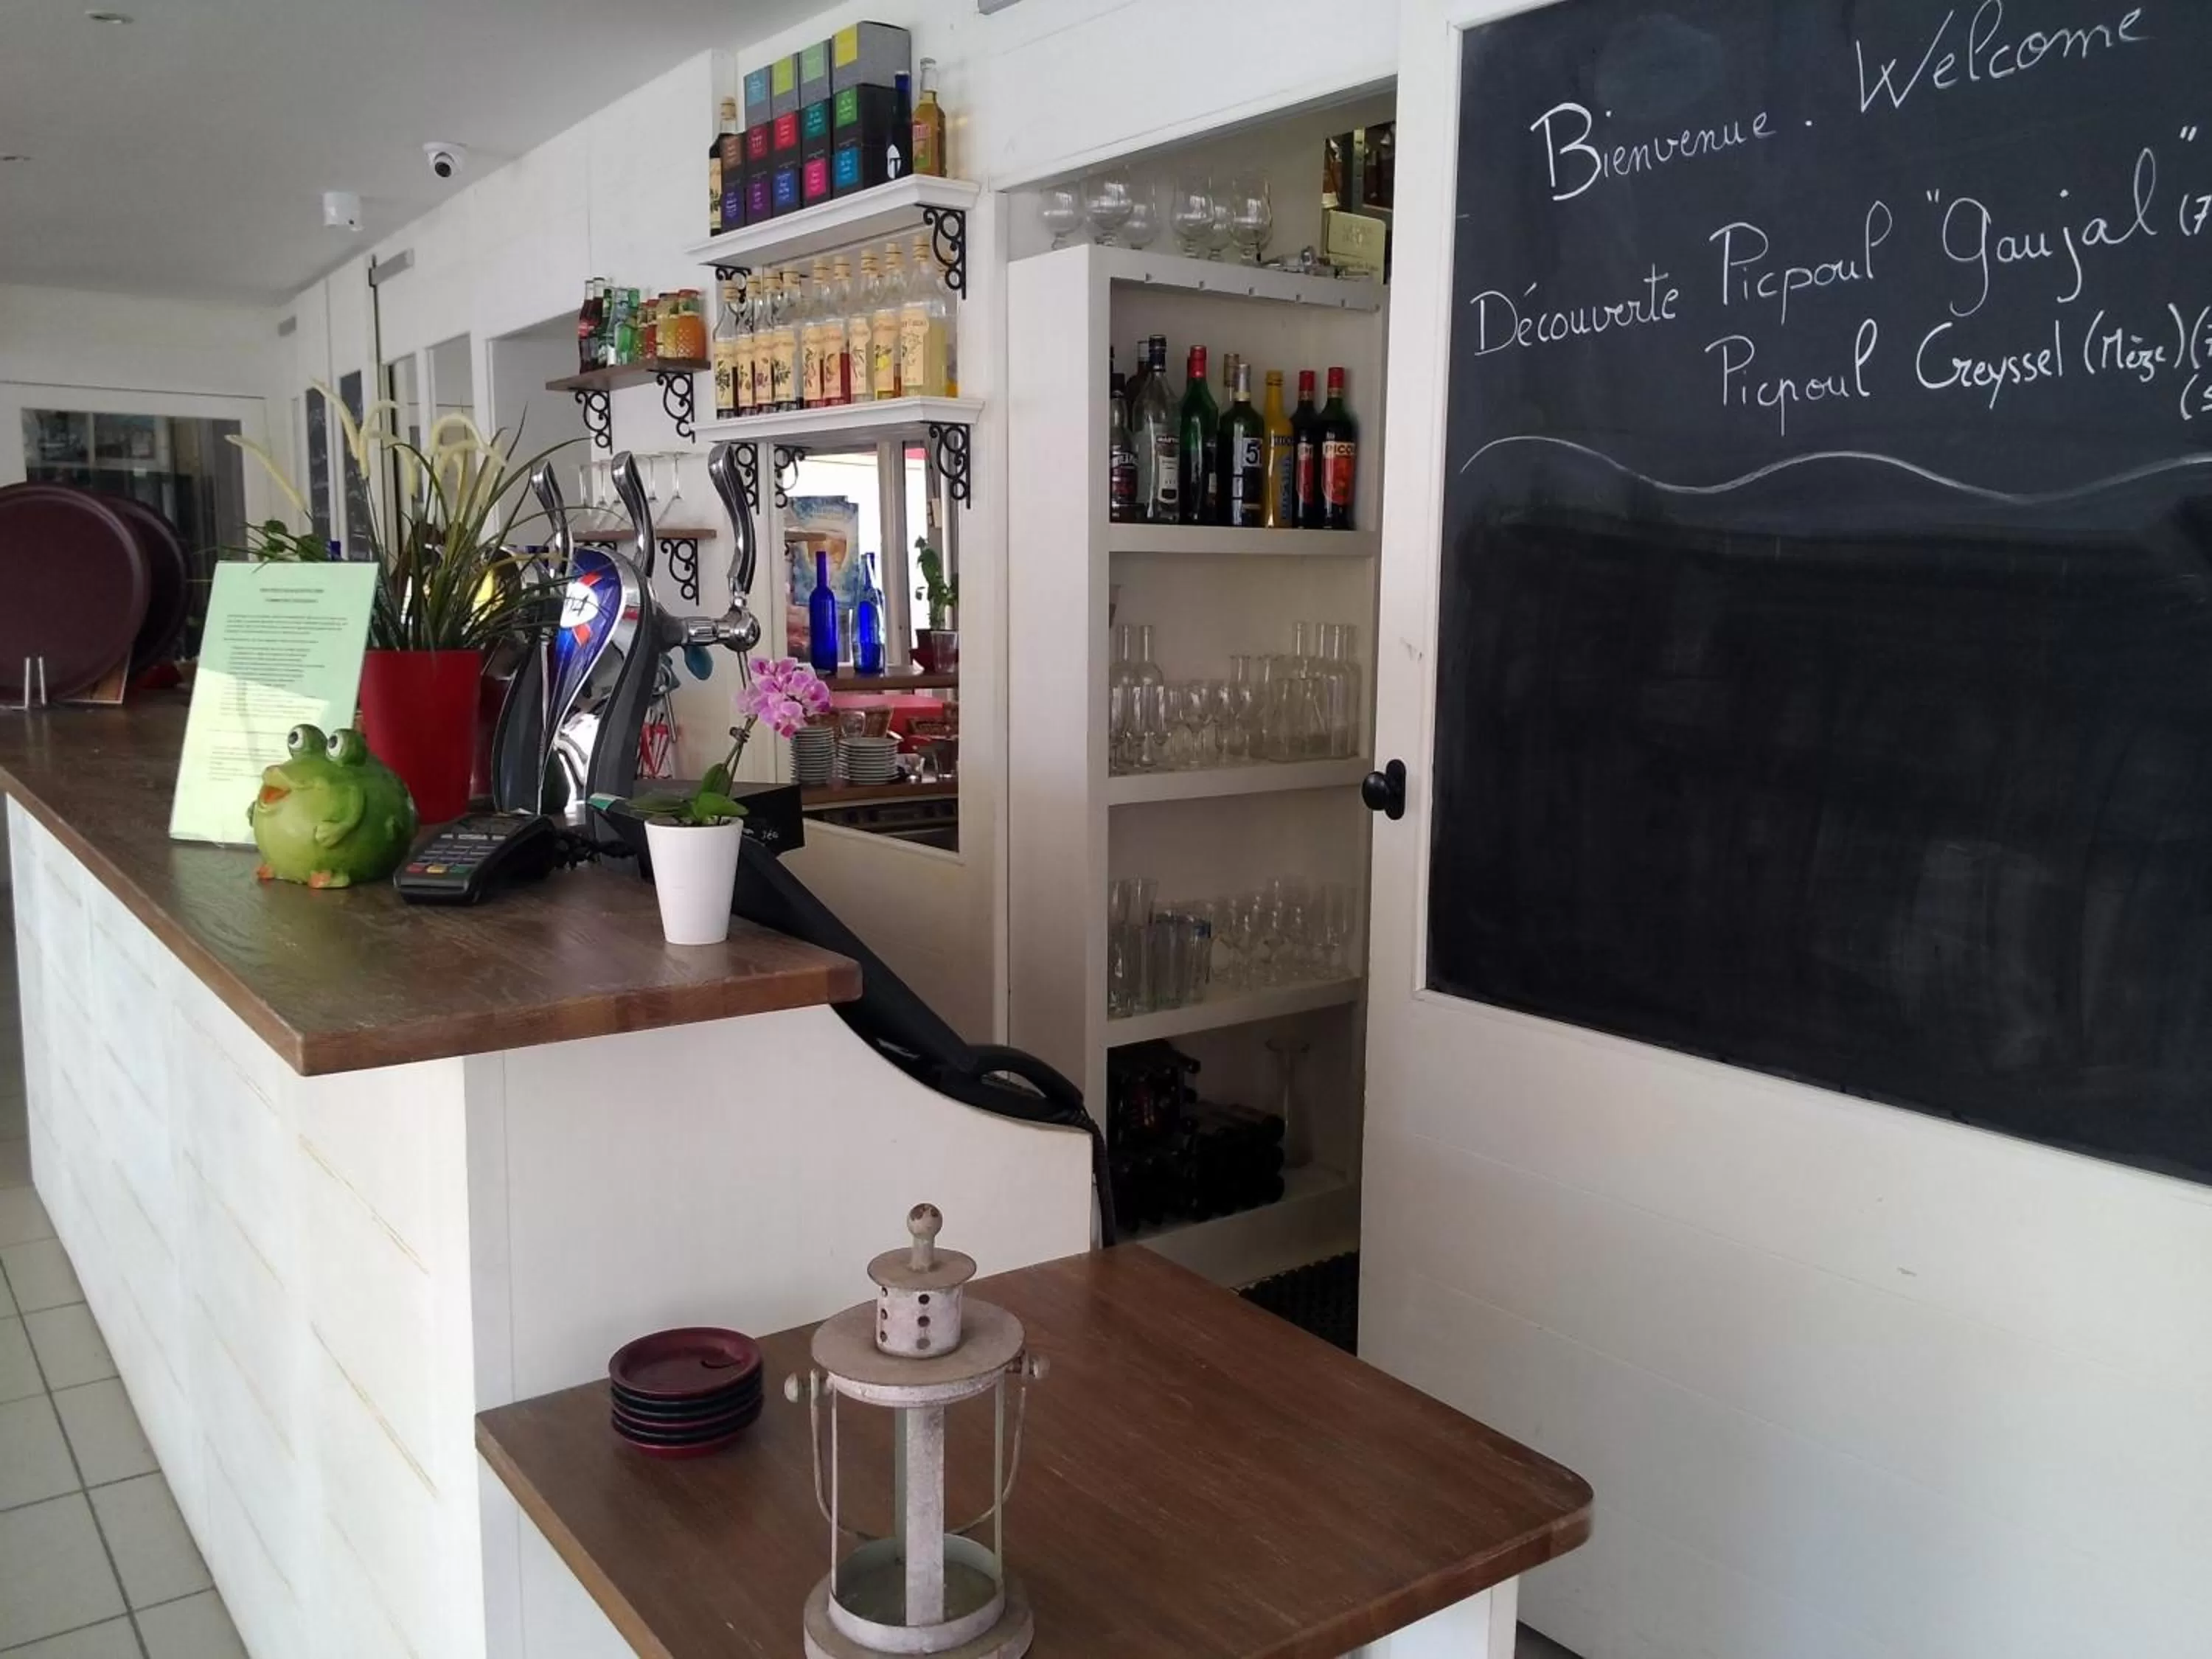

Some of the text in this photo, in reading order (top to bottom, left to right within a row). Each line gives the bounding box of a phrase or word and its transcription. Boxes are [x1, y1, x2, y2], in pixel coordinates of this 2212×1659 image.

[1531, 0, 2145, 201] Bienvenue Welcome
[1470, 263, 1679, 356] Découverte
[1709, 201, 1893, 325] Picpoul
[1705, 318, 1878, 437] Picpoul
[1916, 320, 2063, 409] Creyssel
